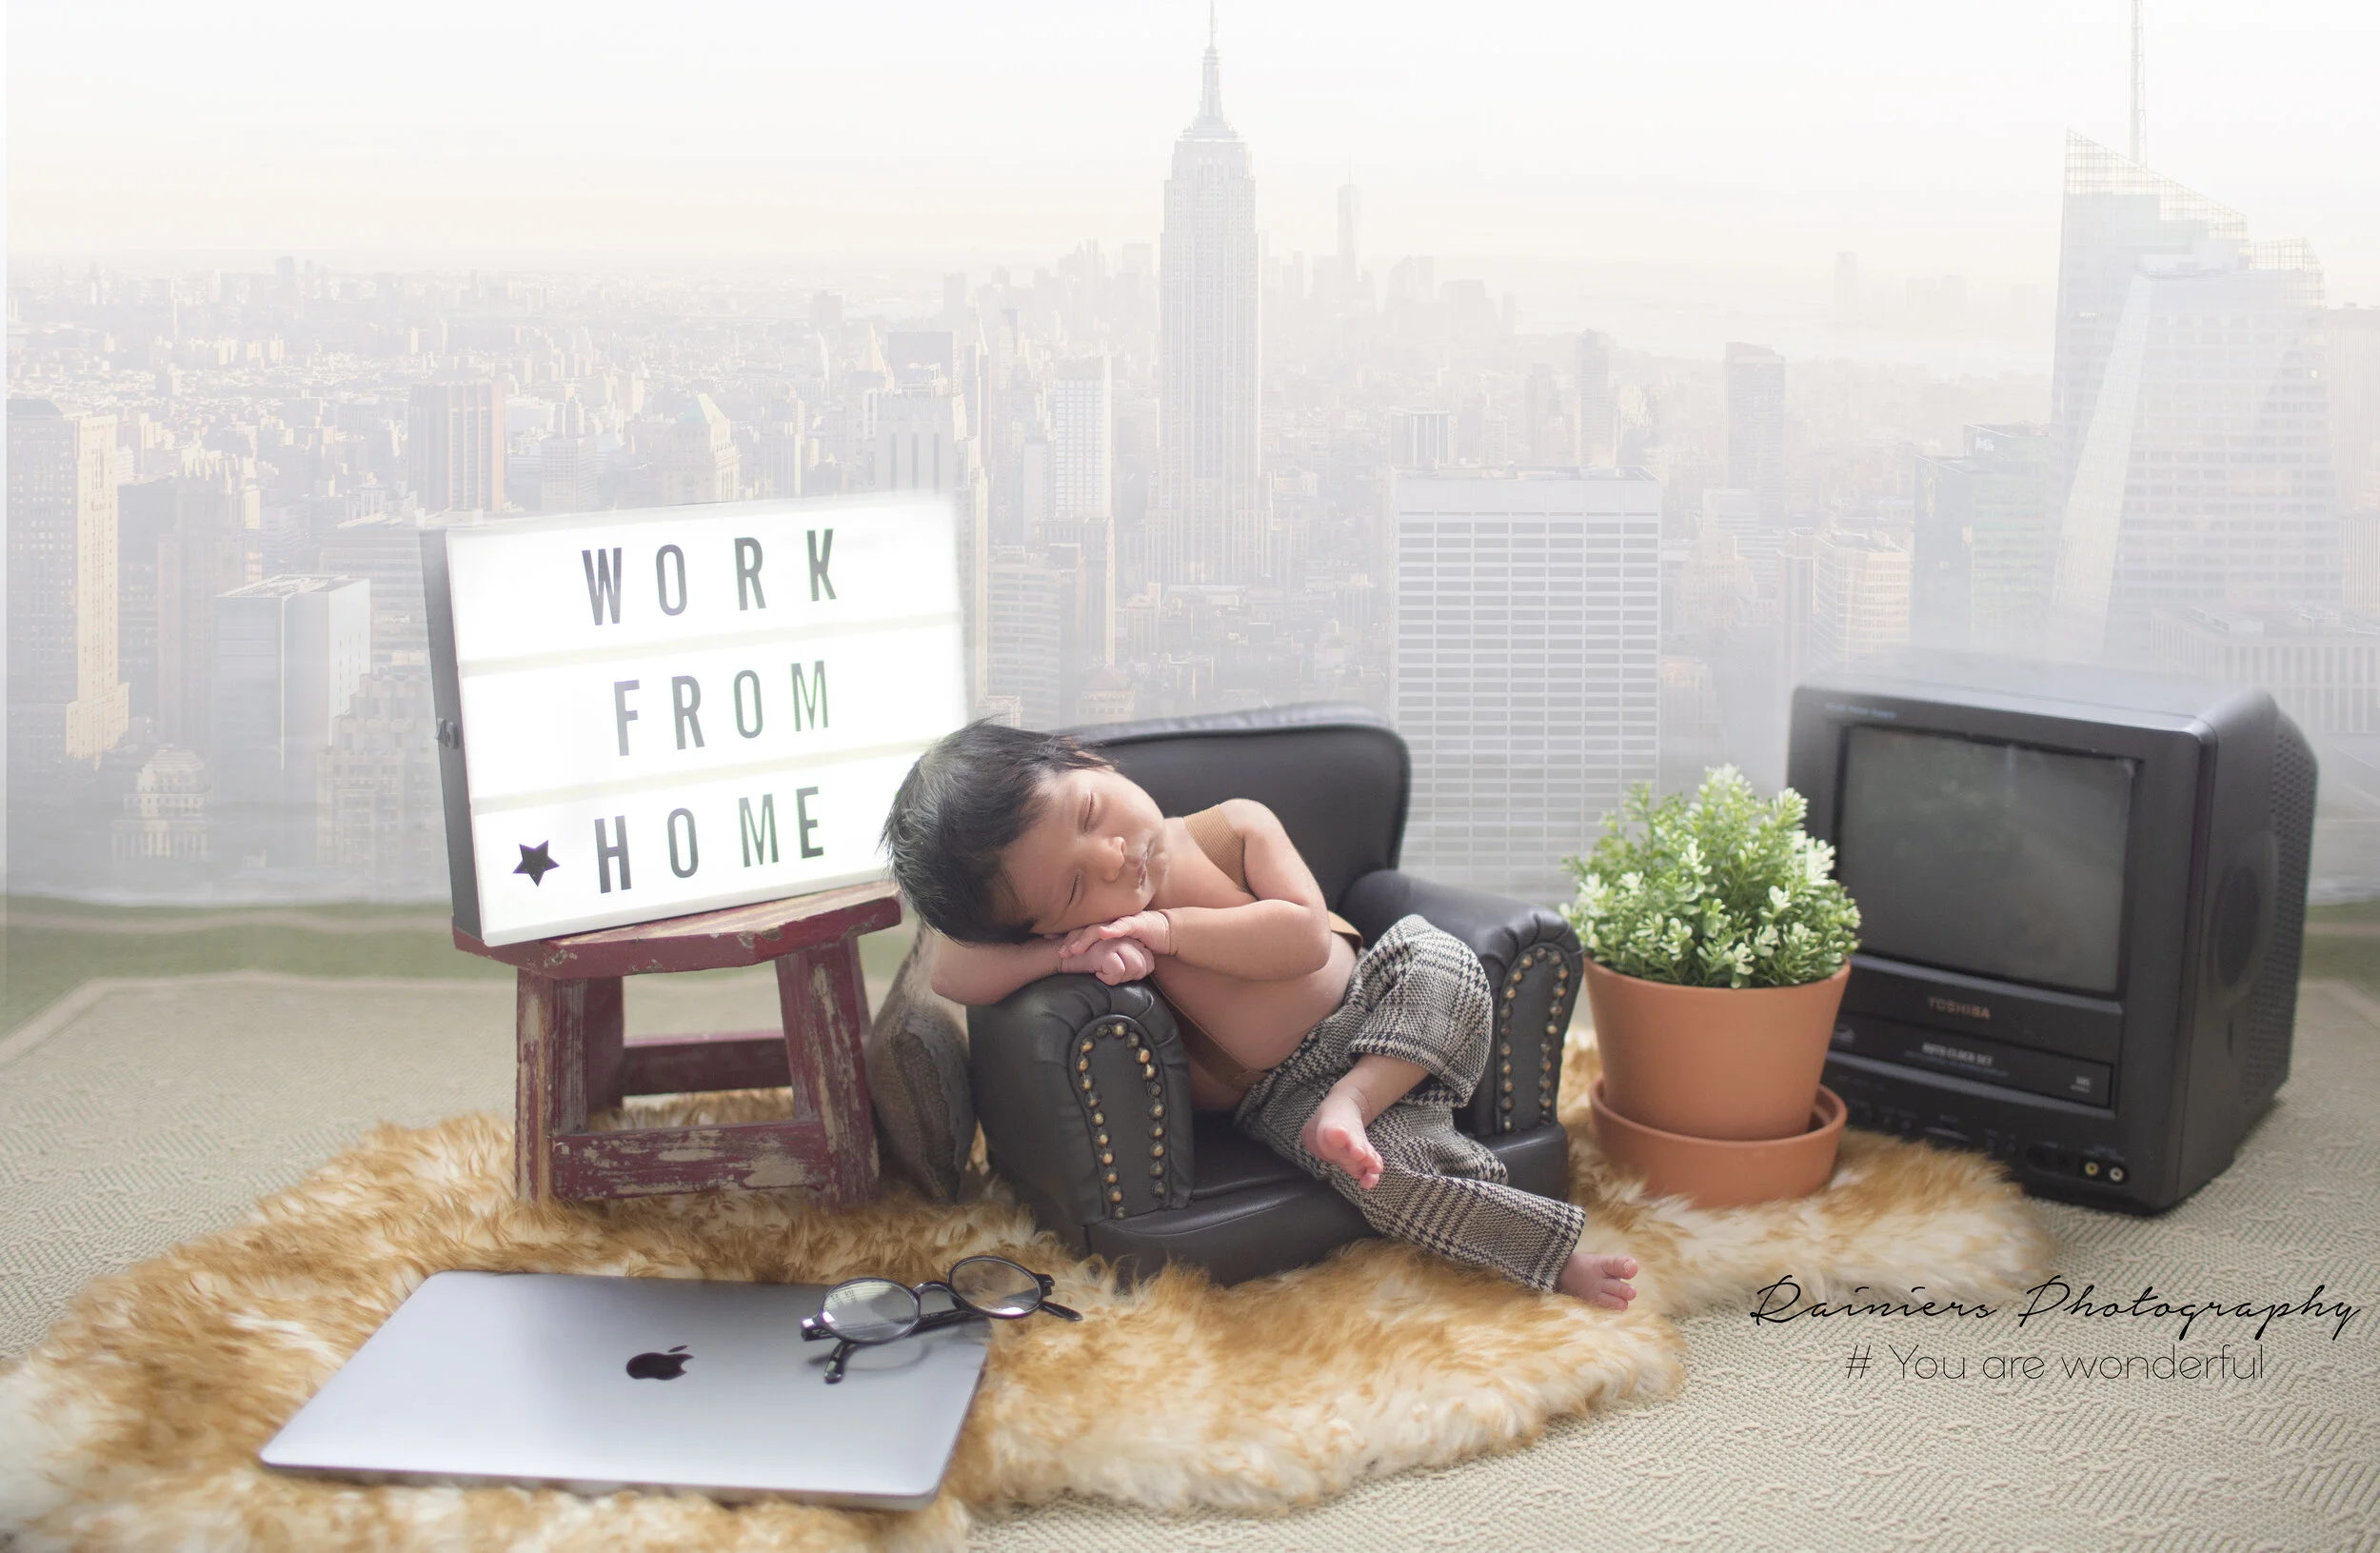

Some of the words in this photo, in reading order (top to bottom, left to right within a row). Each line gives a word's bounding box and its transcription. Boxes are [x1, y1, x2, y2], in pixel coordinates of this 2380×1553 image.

[582, 528, 837, 627] WORK
[614, 660, 829, 757] FROM
[594, 786, 824, 895] HOME
[1928, 996, 1992, 1021] TOSHIBA
